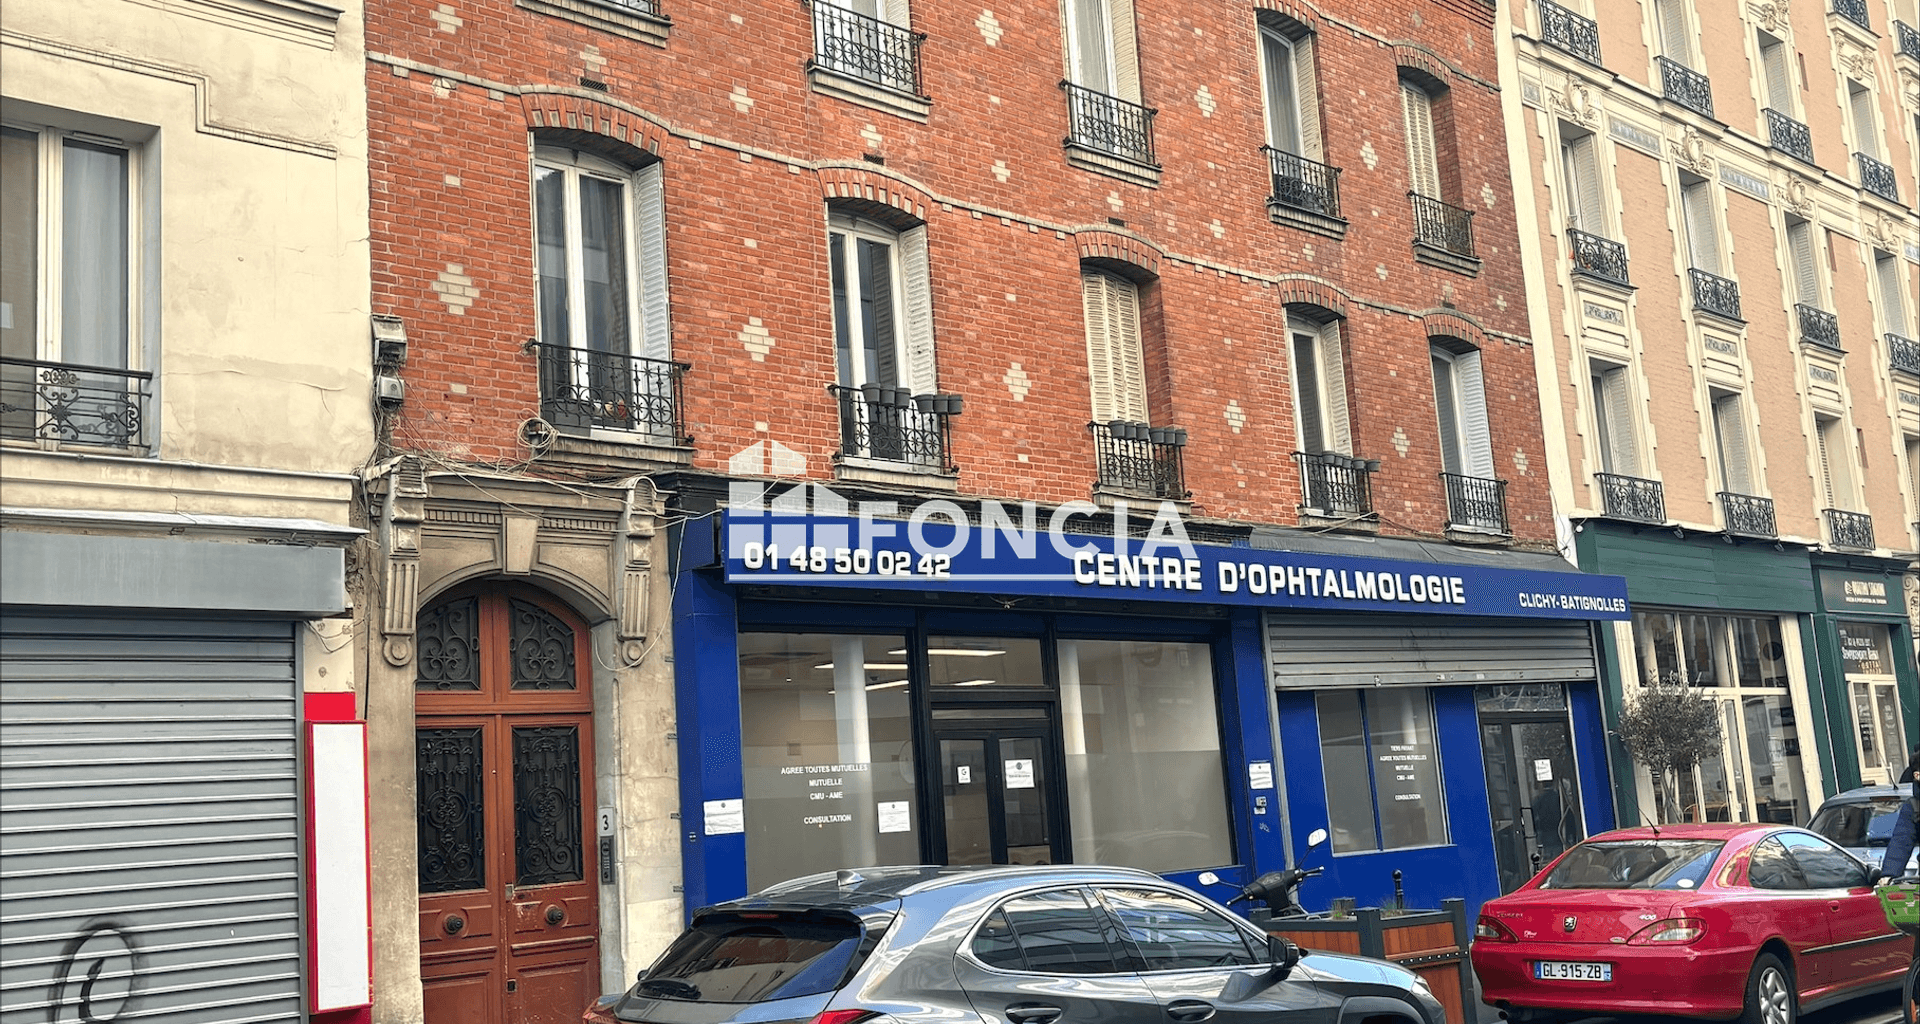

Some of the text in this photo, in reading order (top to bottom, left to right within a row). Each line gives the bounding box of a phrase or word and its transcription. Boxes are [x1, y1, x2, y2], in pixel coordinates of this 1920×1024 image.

[744, 542, 951, 579] 01 48 50 02 42
[1073, 551, 1466, 604] CENTRE D'OPHTALMOLOGIE
[781, 763, 868, 775] AGREE TOUTES MUTUELLES
[808, 778, 843, 787] MUTUELLE
[809, 792, 825, 800] CMU
[602, 814, 609, 831] 3
[803, 814, 852, 825] CONSULTATION
